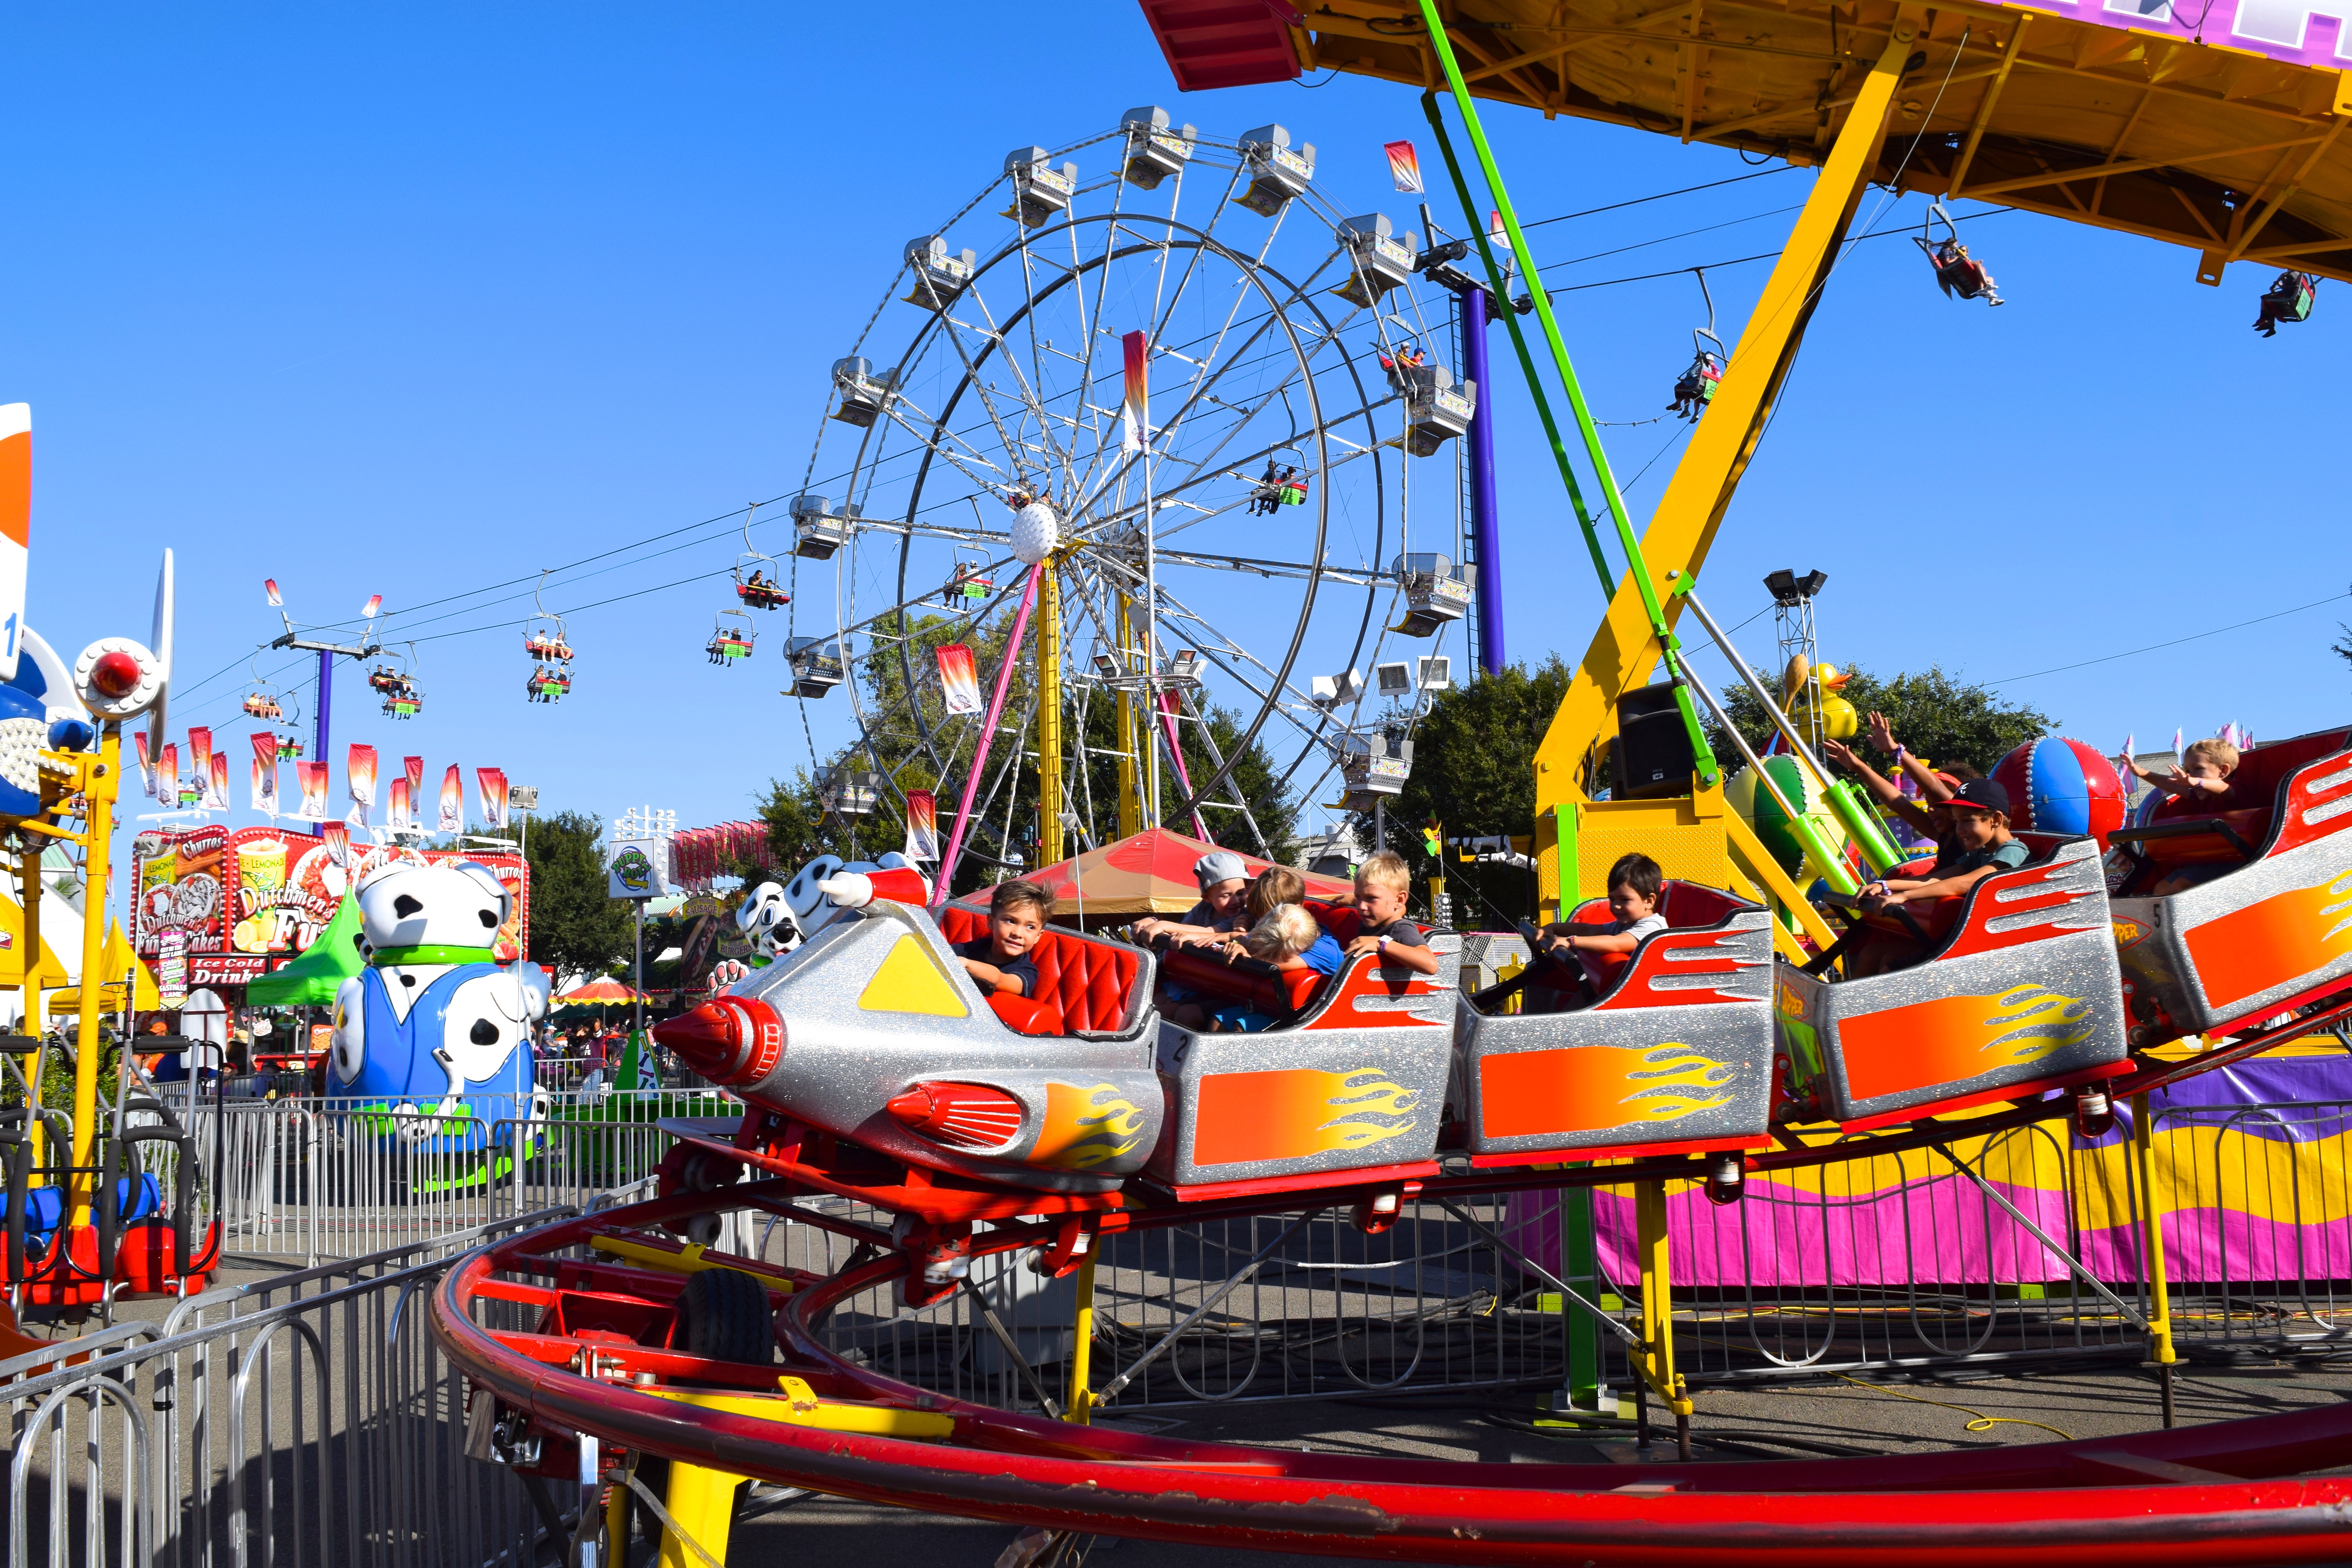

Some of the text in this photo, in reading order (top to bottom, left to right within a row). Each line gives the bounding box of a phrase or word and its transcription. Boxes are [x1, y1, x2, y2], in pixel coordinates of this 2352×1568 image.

[182, 837, 223, 860] Churros
[251, 857, 285, 868] LEMONADE
[612, 852, 646, 874] PUPPY
[623, 863, 651, 878] ROLL
[238, 879, 336, 919] Dutchmen's
[686, 904, 718, 916] SAUSAGE
[145, 908, 201, 936] Dutchmen's
[2153, 904, 2161, 928] 5
[138, 932, 159, 954] Fun
[720, 944, 752, 956] BURGERS
[194, 959, 222, 968] Ice
[223, 958, 265, 968] Cold
[1148, 1041, 1153, 1069] 1
[1173, 1034, 1188, 1063] 2
